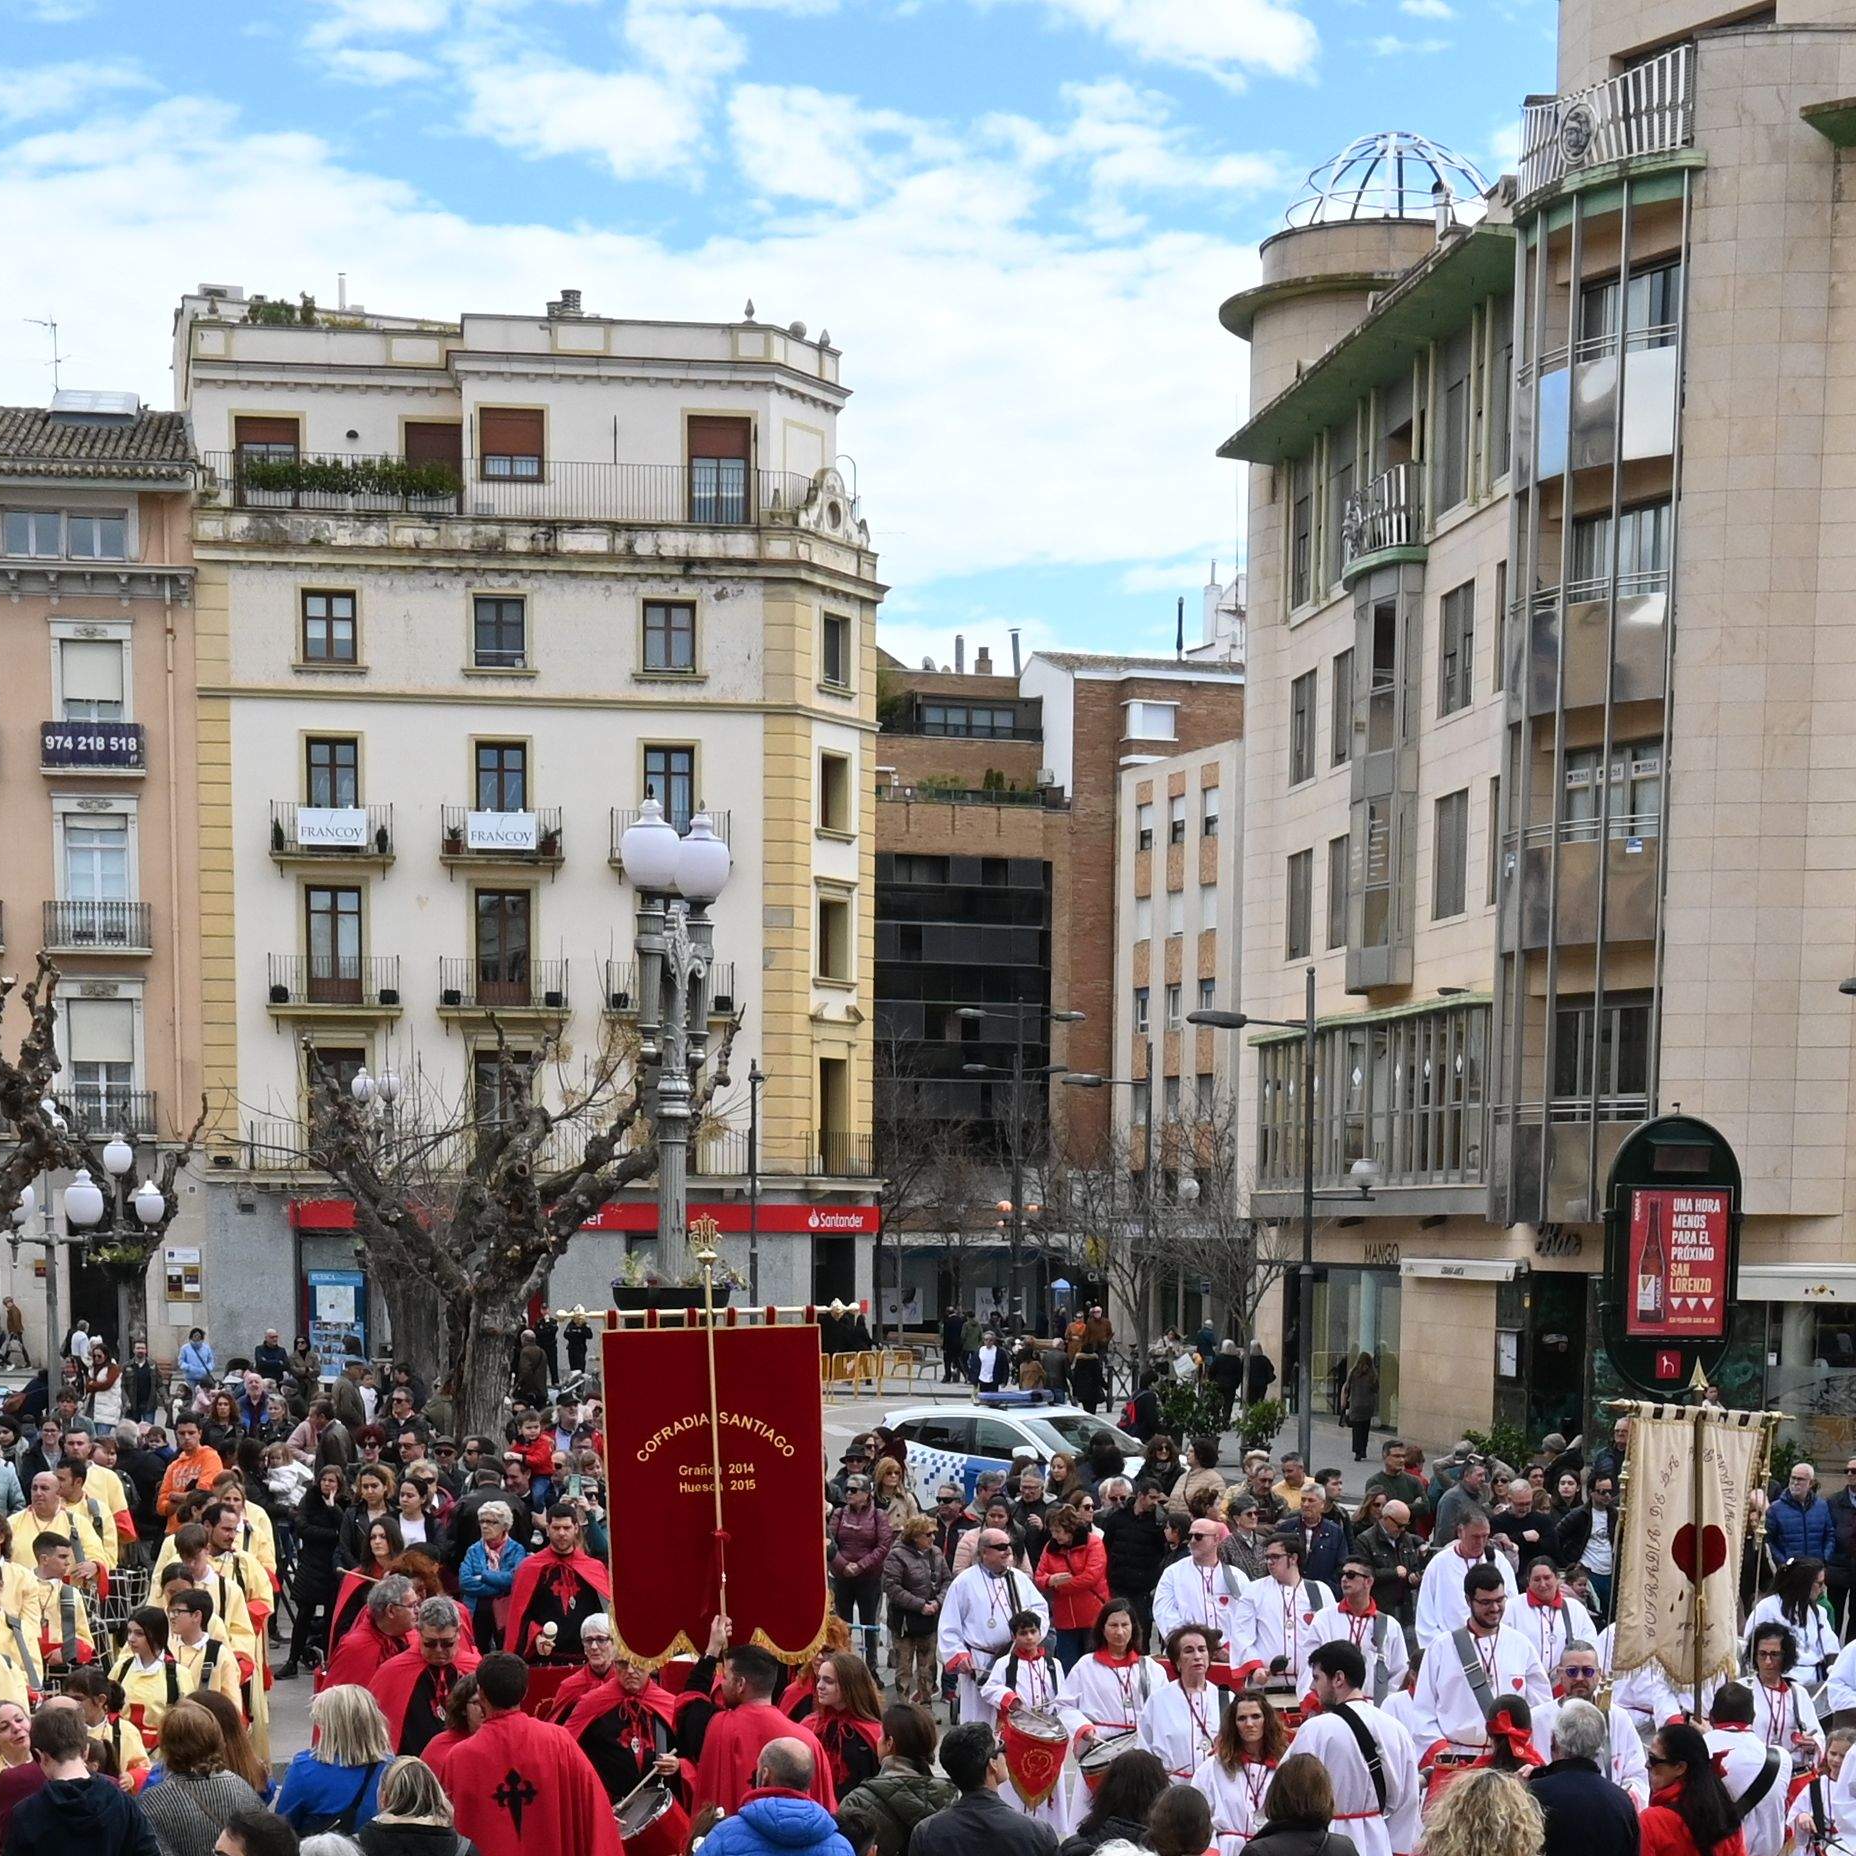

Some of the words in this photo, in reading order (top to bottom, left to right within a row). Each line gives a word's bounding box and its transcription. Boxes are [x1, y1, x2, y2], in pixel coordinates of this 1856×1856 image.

[45, 735, 73, 750] 974
[77, 736, 105, 751] 218
[109, 737, 138, 752] 518
[1673, 1198, 1693, 1213] UNA
[1695, 1198, 1721, 1213] HORA
[820, 1213, 863, 1228] Santander
[1672, 1214, 1707, 1229] MENOS
[1671, 1230, 1697, 1245] PARA
[1699, 1231, 1711, 1245] EL
[1364, 1243, 1400, 1264] MANGO
[1670, 1245, 1715, 1261] PRÓXIMO
[1670, 1263, 1690, 1277] SAN
[1669, 1278, 1712, 1294] LORENZO
[636, 1412, 709, 1462] COFRADIA
[718, 1411, 795, 1459] SANTIAGO
[728, 1463, 755, 1475] 2014
[730, 1479, 756, 1491] 2015
